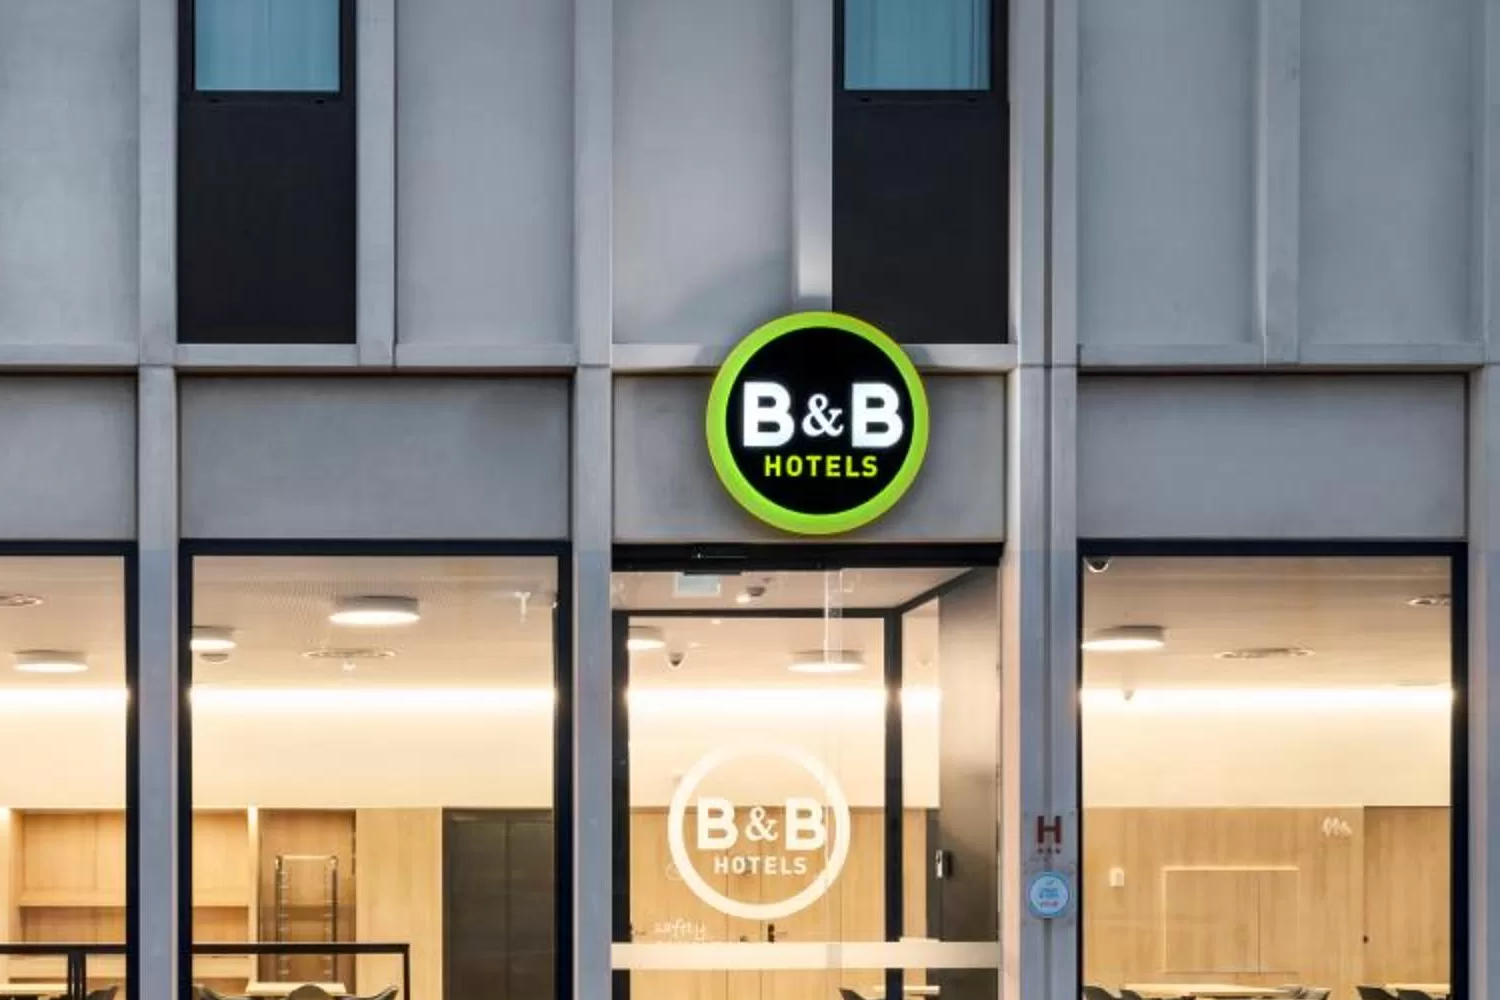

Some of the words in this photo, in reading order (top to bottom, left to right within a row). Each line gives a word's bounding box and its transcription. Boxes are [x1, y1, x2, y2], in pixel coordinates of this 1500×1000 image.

[743, 381, 903, 448] B&B
[764, 455, 878, 477] HOTELS
[697, 798, 826, 850] B&B
[1037, 815, 1062, 844] H
[713, 856, 808, 875] HOTELS
